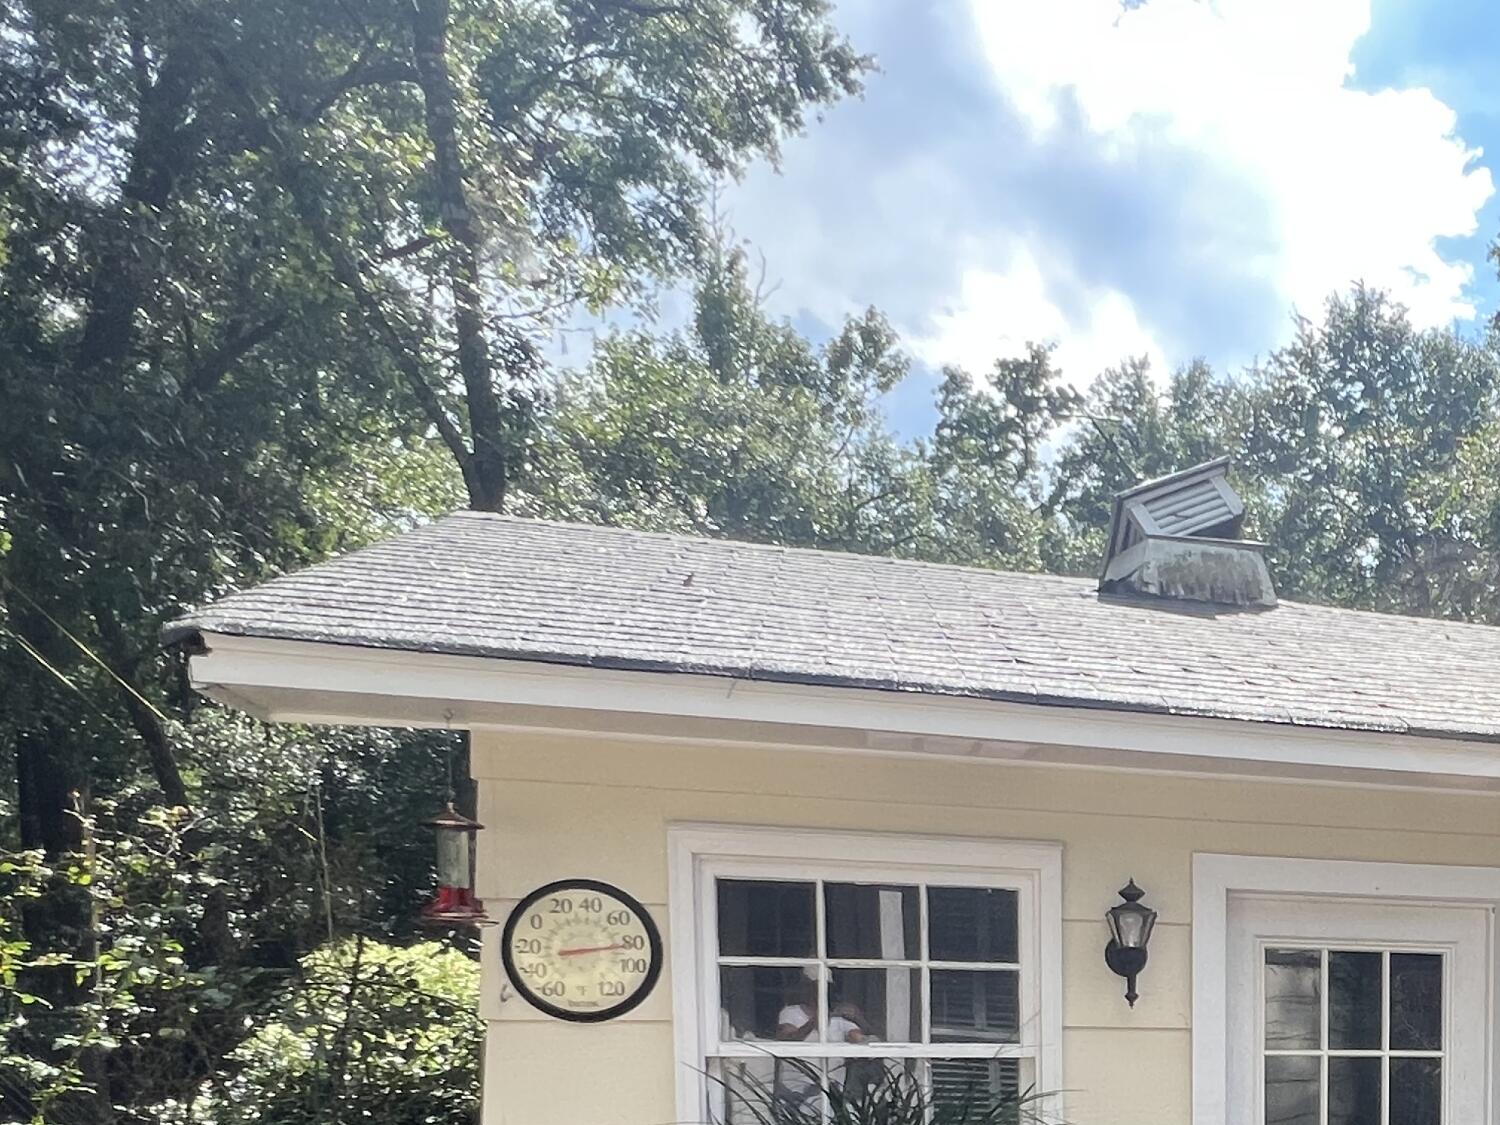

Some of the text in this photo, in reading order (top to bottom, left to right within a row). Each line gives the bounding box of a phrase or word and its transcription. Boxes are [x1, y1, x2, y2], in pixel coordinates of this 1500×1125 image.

[549, 898, 572, 913] 20
[579, 897, 602, 913] 40
[530, 914, 542, 929] 0
[607, 911, 630, 926] 60
[622, 935, 644, 950] 80
[621, 959, 646, 973] 100
[599, 981, 625, 996] 120
